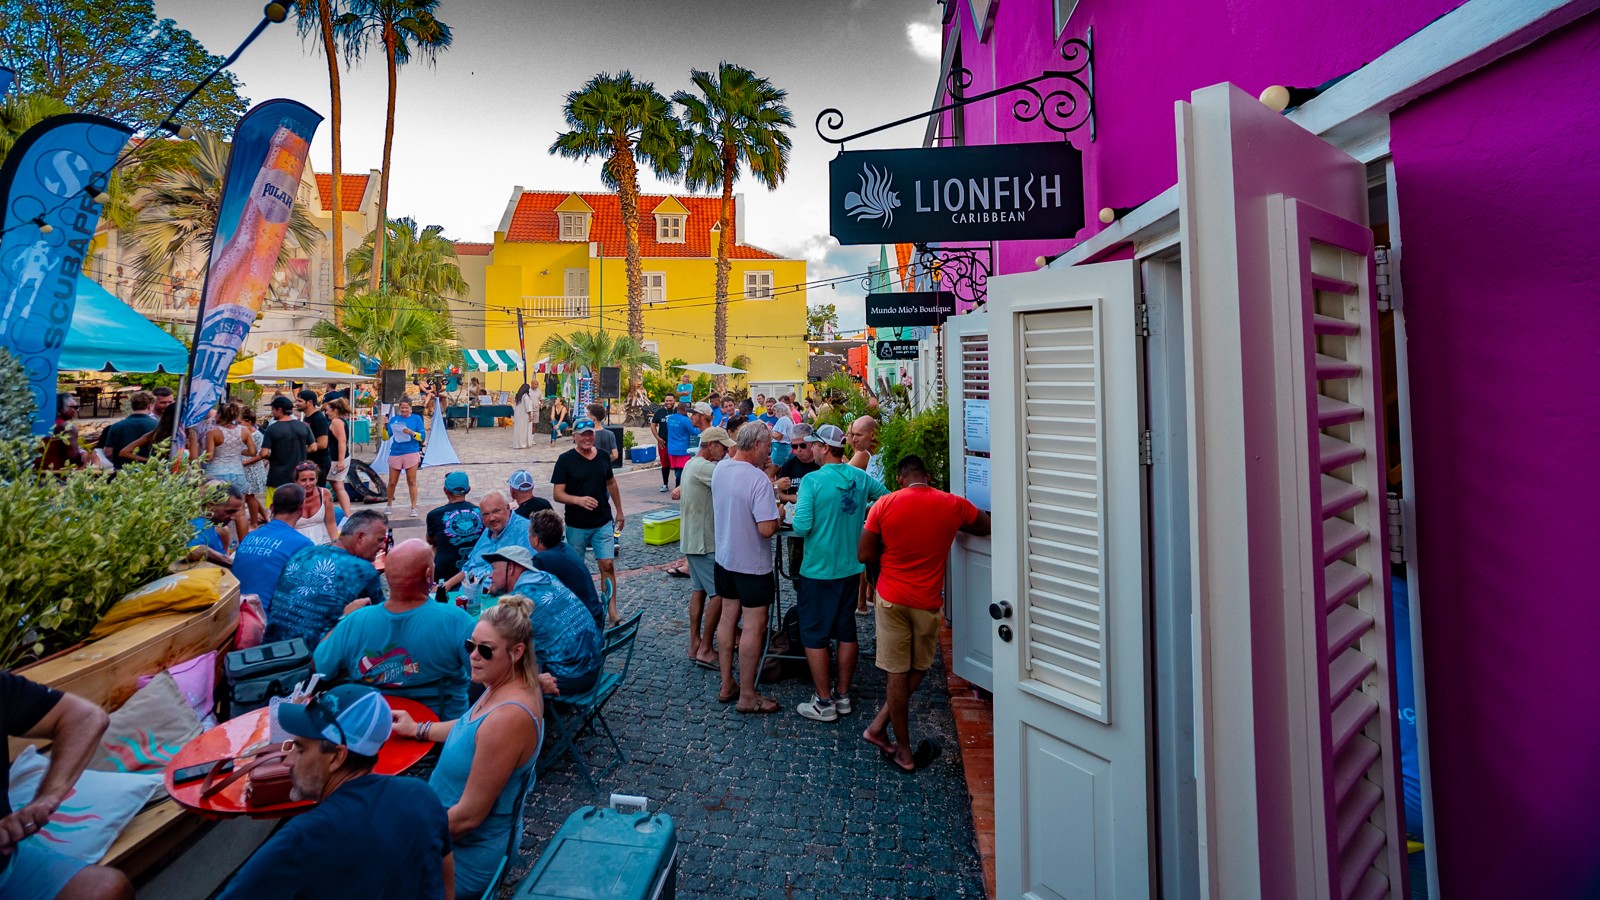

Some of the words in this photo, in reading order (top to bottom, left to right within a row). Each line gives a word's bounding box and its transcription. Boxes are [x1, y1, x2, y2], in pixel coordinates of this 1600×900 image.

[262, 182, 294, 209] POLAR
[915, 172, 1062, 213] LIONFISH
[951, 211, 1026, 224] CARIBBEAN
[43, 171, 108, 350] SCUBAPRO
[870, 306, 897, 315] Mundo
[898, 305, 918, 314] Mio's
[919, 304, 952, 315] Boutique
